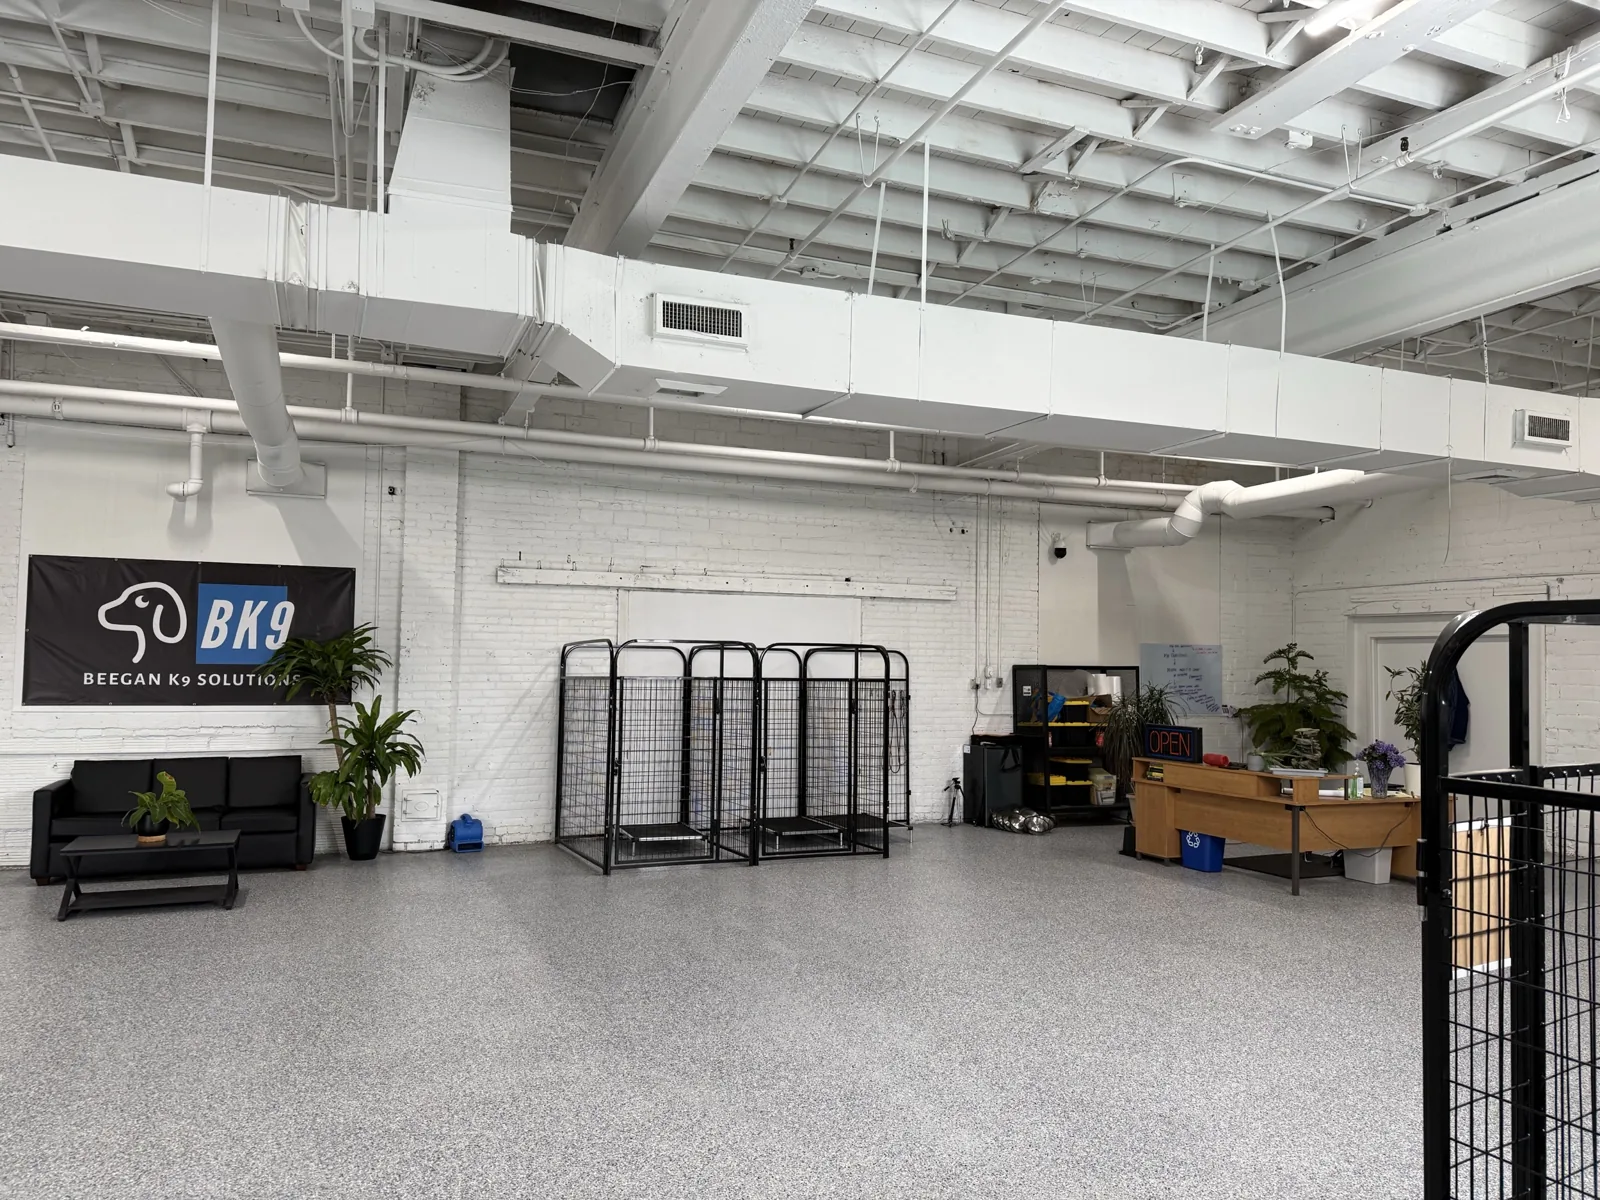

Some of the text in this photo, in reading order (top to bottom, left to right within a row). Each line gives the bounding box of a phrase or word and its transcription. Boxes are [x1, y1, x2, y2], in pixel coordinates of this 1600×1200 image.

[200, 599, 295, 650] BK9
[83, 672, 161, 686] BEEGAN
[169, 673, 191, 687] K9
[1149, 730, 1190, 757] OPEN
